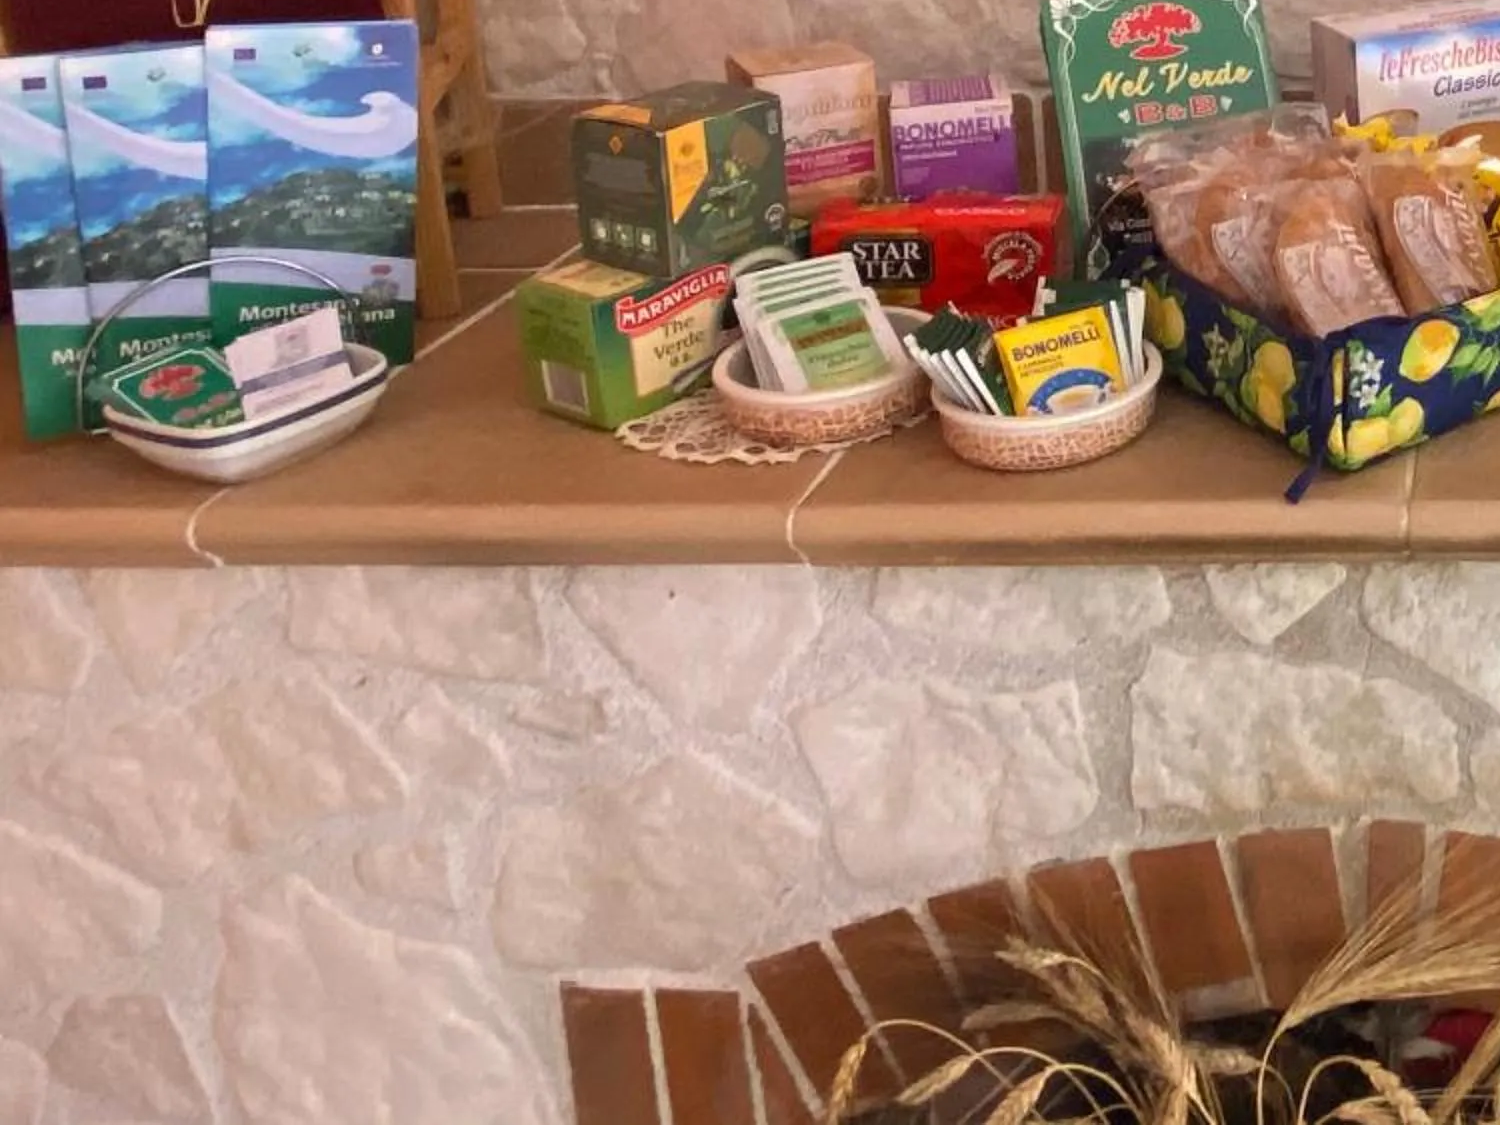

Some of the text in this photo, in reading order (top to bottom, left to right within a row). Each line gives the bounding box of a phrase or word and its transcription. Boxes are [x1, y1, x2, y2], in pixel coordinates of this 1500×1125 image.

[1081, 59, 1254, 103] Nel Verde
[852, 241, 922, 261] STAR
[860, 259, 916, 280] TEA
[621, 269, 727, 326] MARAVIGLIA
[1012, 324, 1101, 362] BONOMELLI
